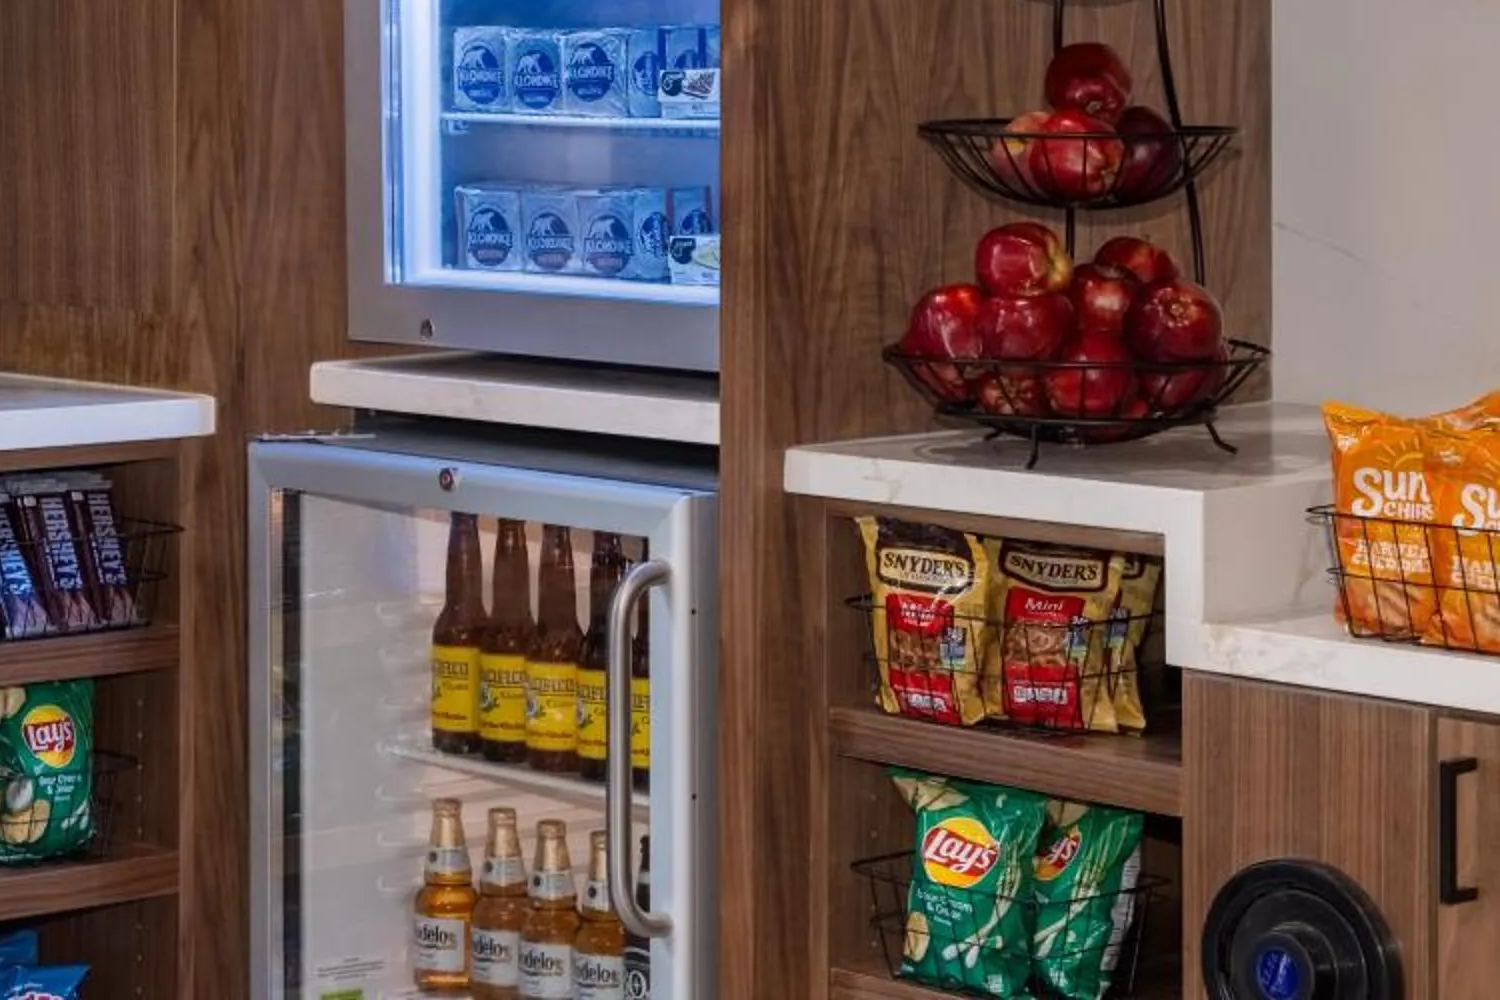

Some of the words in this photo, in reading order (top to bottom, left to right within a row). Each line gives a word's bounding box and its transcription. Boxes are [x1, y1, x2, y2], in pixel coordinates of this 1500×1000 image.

[1351, 467, 1431, 519] Sun
[1383, 501, 1434, 520] CHIPS
[1451, 483, 1500, 536] Su
[40, 497, 83, 590] HERSHEY'S
[87, 492, 127, 585] HERSHEY'S
[883, 552, 965, 578] SNYDER'S
[1010, 555, 1098, 581] SNYDER'S
[1025, 597, 1064, 611] Mini
[924, 829, 998, 874] Lay's
